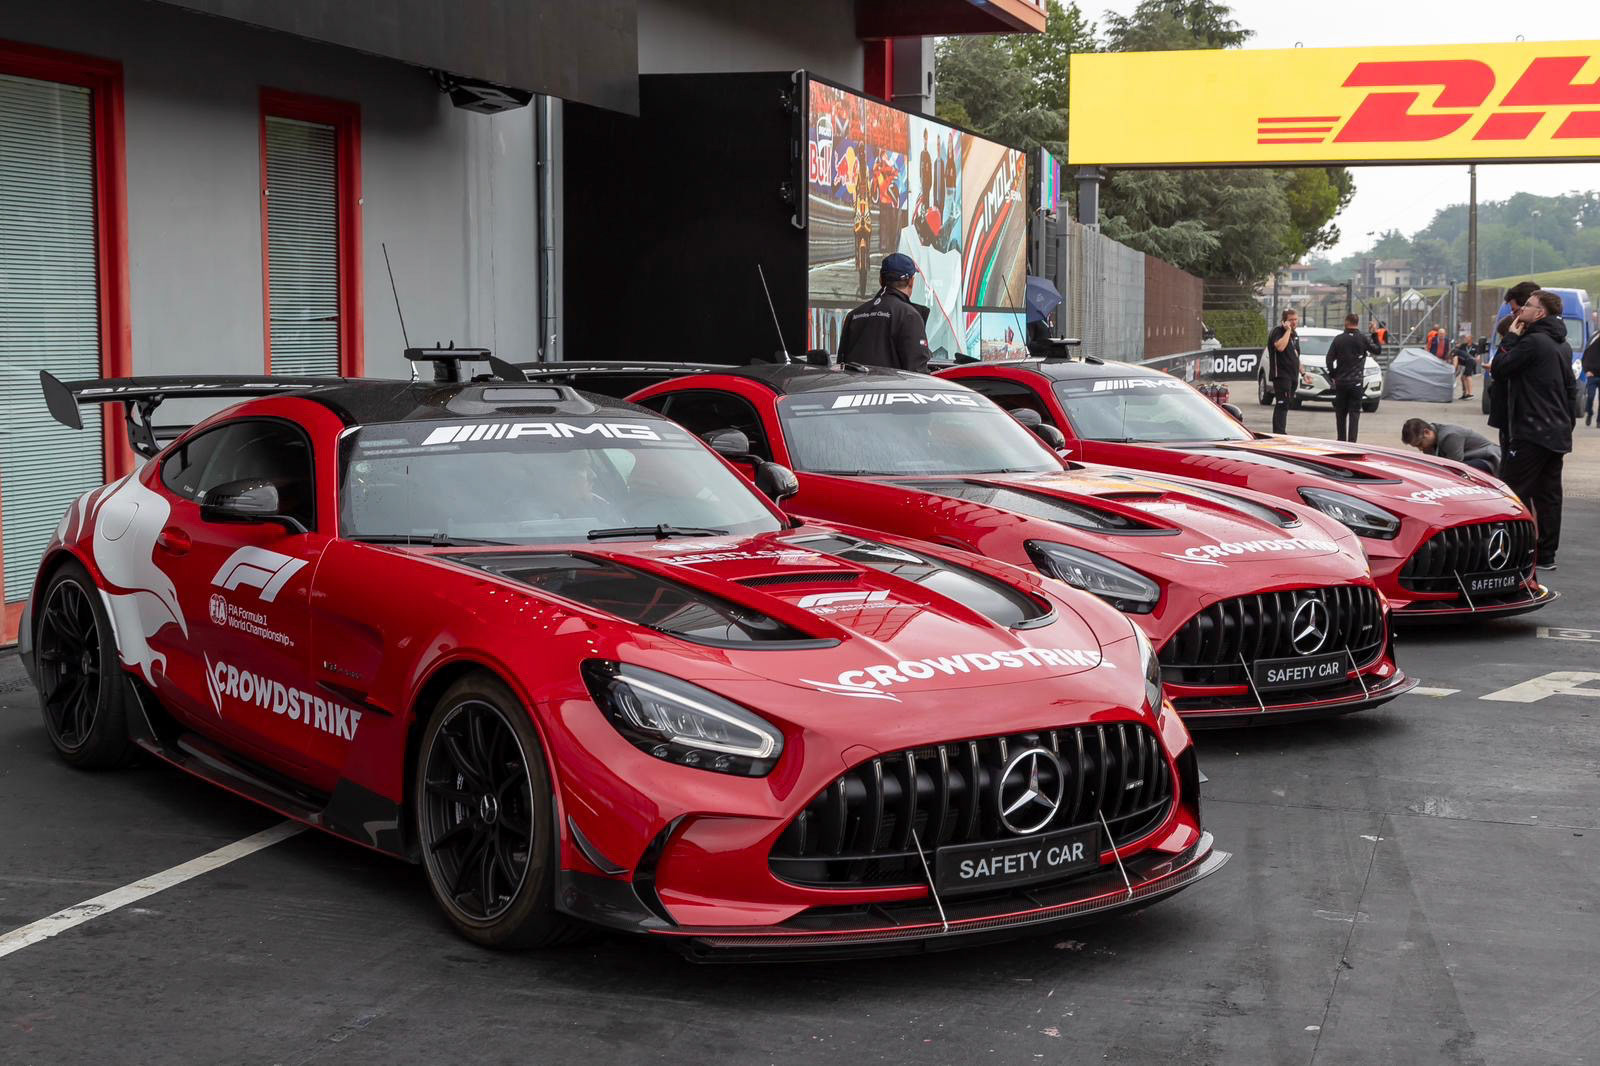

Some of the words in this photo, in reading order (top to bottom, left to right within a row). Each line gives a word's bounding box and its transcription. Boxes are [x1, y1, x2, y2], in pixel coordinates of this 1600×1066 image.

[984, 148, 1017, 232] IMOLA
[504, 422, 662, 441] AMG
[210, 545, 310, 603] F1
[1471, 578, 1504, 591] SAFETY
[1503, 575, 1515, 588] CAR
[228, 603, 238, 617] FIA
[239, 607, 264, 625] Formula
[228, 616, 246, 631] World
[246, 622, 290, 647] Championship
[838, 648, 1116, 689] CROWDSTRIKE
[1267, 666, 1316, 683] SAFETY
[1318, 661, 1340, 677] CAR
[959, 850, 1042, 880] SAFETY
[1046, 842, 1085, 867] CAR
